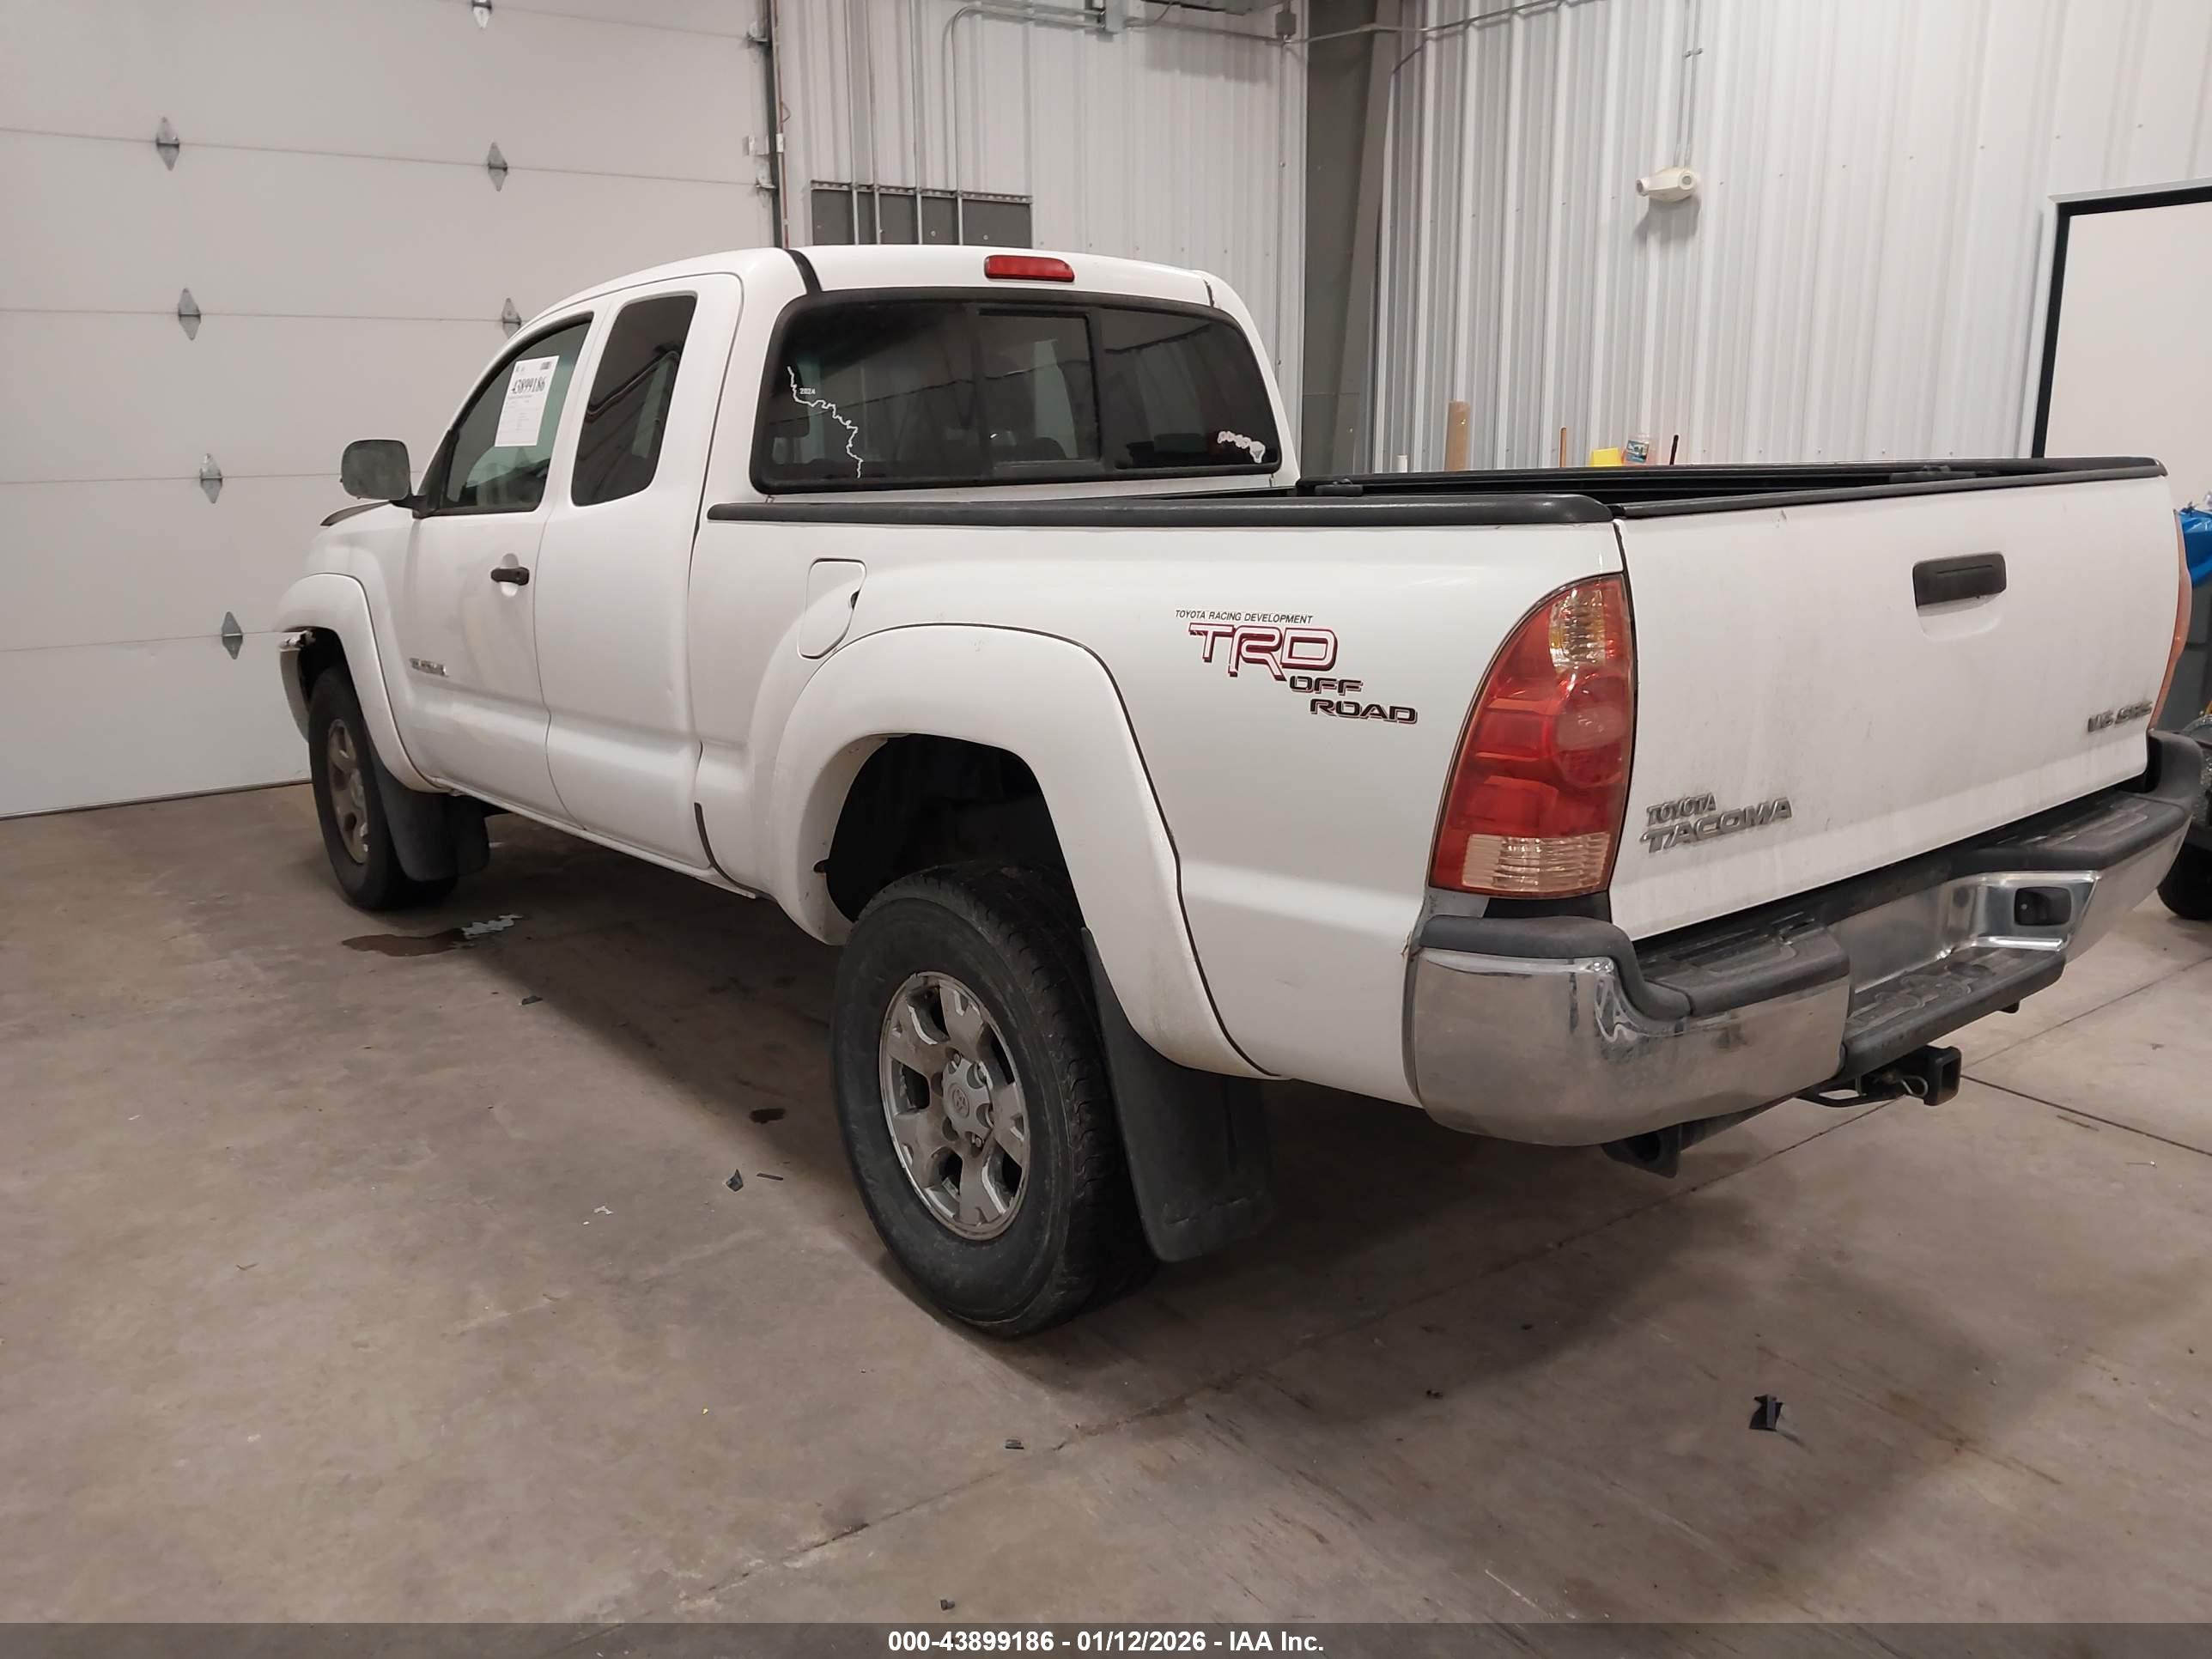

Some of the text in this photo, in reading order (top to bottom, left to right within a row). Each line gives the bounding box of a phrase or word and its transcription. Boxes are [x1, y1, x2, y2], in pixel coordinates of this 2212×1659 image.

[1175, 610, 1314, 624] TOYOTA RACING DEVELOPMENT
[1188, 622, 1339, 681] TRD
[1290, 675, 1364, 696] OFF
[1310, 698, 1419, 724] ROAD
[1646, 792, 1717, 826] TOYOTA
[1639, 797, 1792, 854] TACOMA
